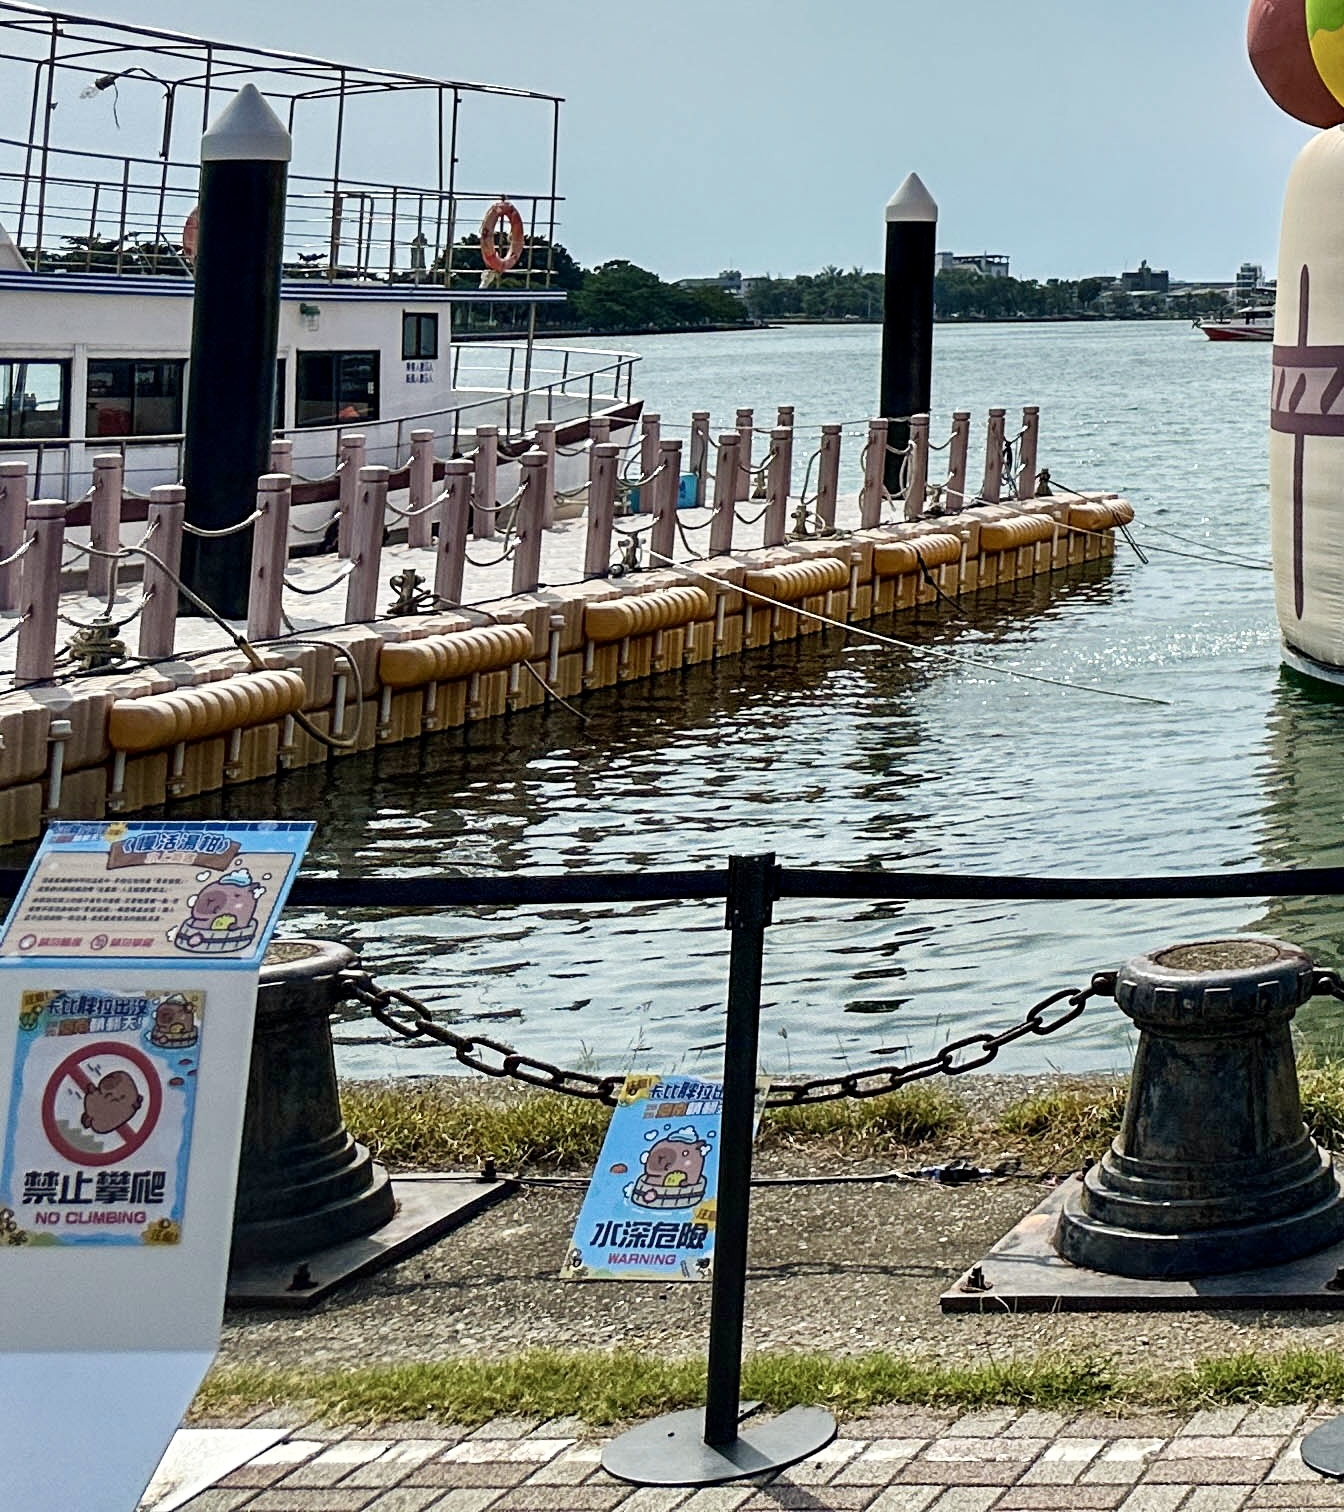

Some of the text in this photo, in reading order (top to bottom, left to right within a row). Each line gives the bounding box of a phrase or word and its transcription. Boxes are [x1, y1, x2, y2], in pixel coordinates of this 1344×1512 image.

[22, 1170, 167, 1205] 禁止攀爬
[35, 1211, 147, 1224] NO CLIMBING
[590, 1221, 709, 1249] 水深危險
[608, 1253, 676, 1265] WARNING
